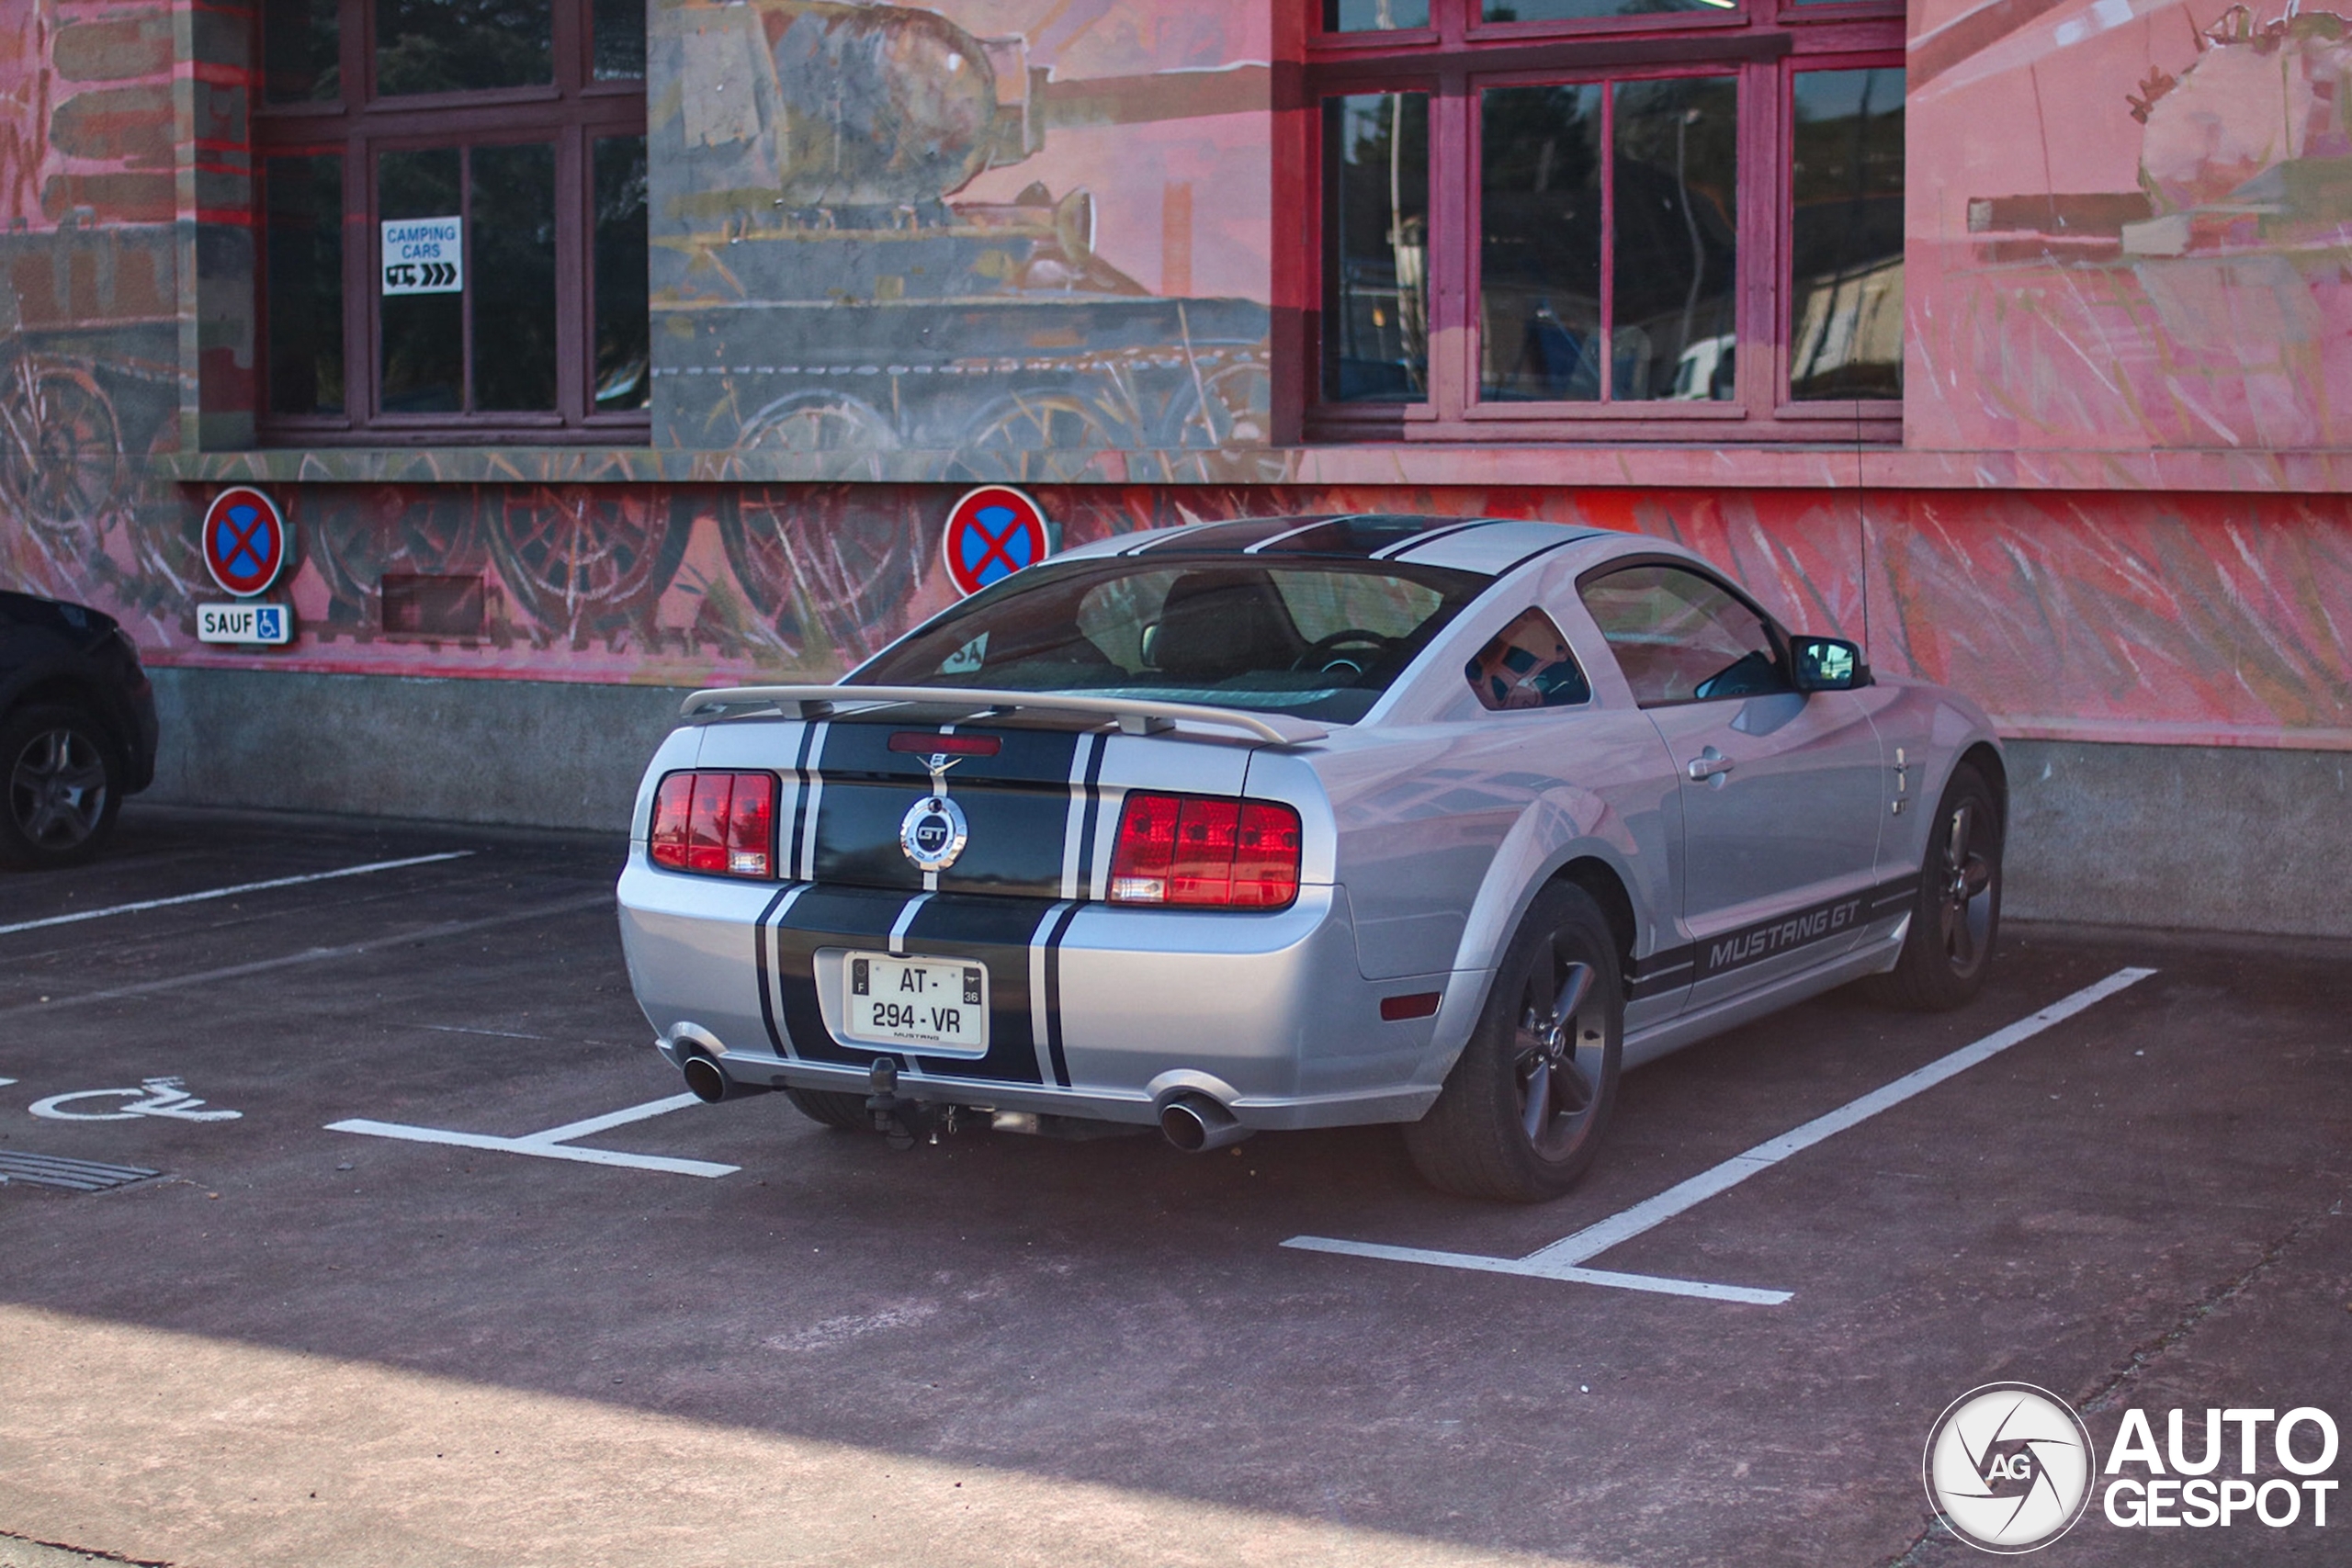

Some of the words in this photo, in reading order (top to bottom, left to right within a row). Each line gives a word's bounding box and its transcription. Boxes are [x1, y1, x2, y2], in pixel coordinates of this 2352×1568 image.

[387, 226, 456, 243] CAMPING
[401, 243, 441, 259] CARS
[205, 613, 253, 633] SAUF
[918, 828, 945, 840] GT
[1709, 909, 1828, 969] MUSTANG
[1830, 899, 1860, 929] GT
[857, 983, 865, 992] F
[965, 992, 978, 1002] 36
[894, 1032, 940, 1041] MUSTANG
